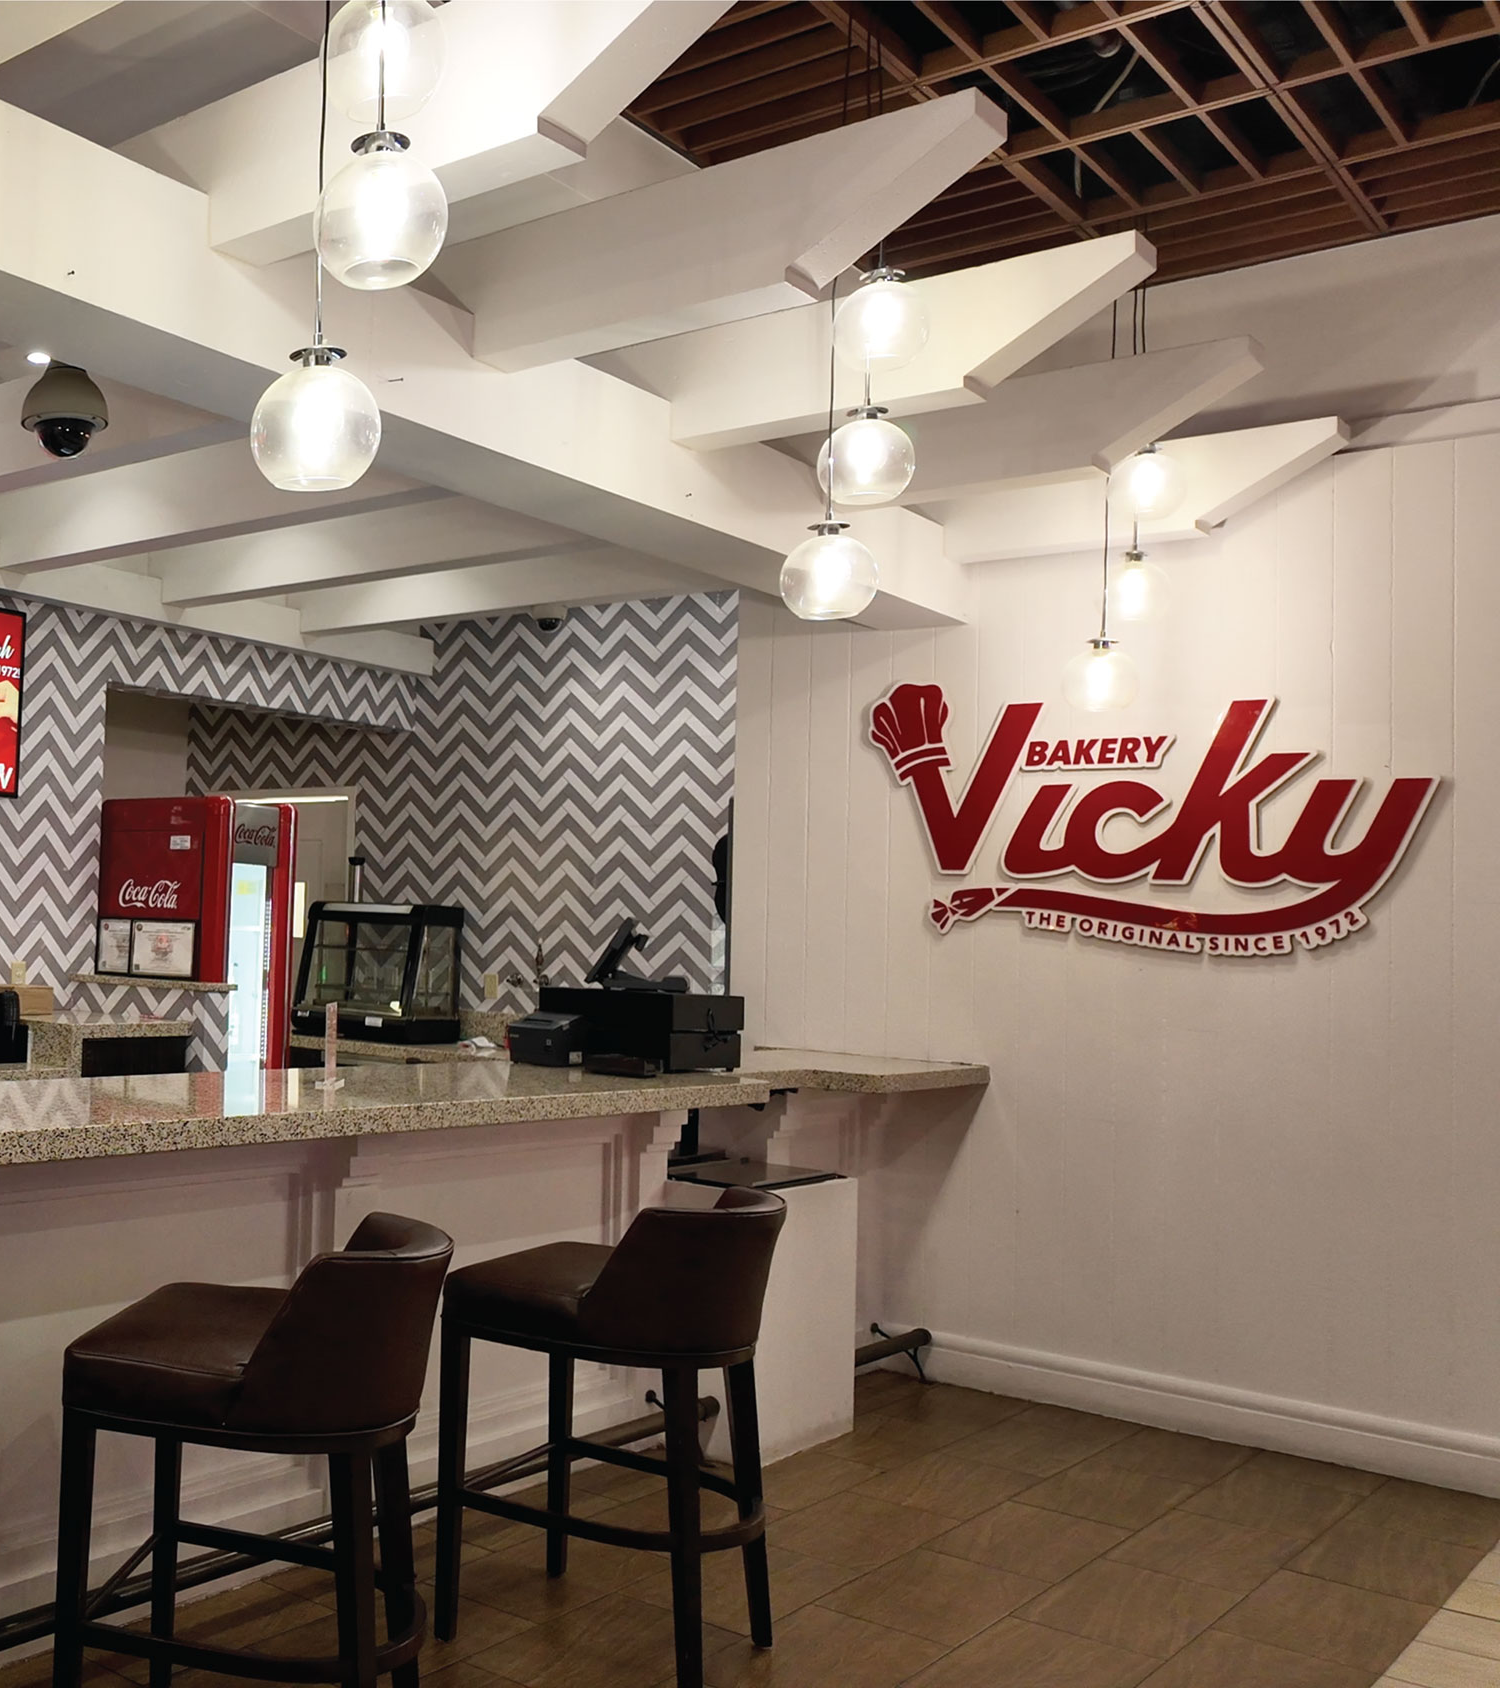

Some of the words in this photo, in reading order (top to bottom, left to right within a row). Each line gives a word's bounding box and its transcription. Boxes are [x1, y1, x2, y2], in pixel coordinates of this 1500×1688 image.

[1024, 734, 1168, 767] BAKERY
[883, 688, 1434, 915] Vicky
[234, 822, 277, 848] Coca-Cola
[118, 878, 182, 909] Coca-Cola
[1025, 910, 1067, 929] THE
[1078, 917, 1196, 950] ORIGINAL
[1209, 934, 1285, 953] SINCE
[1299, 910, 1360, 945] 1972
